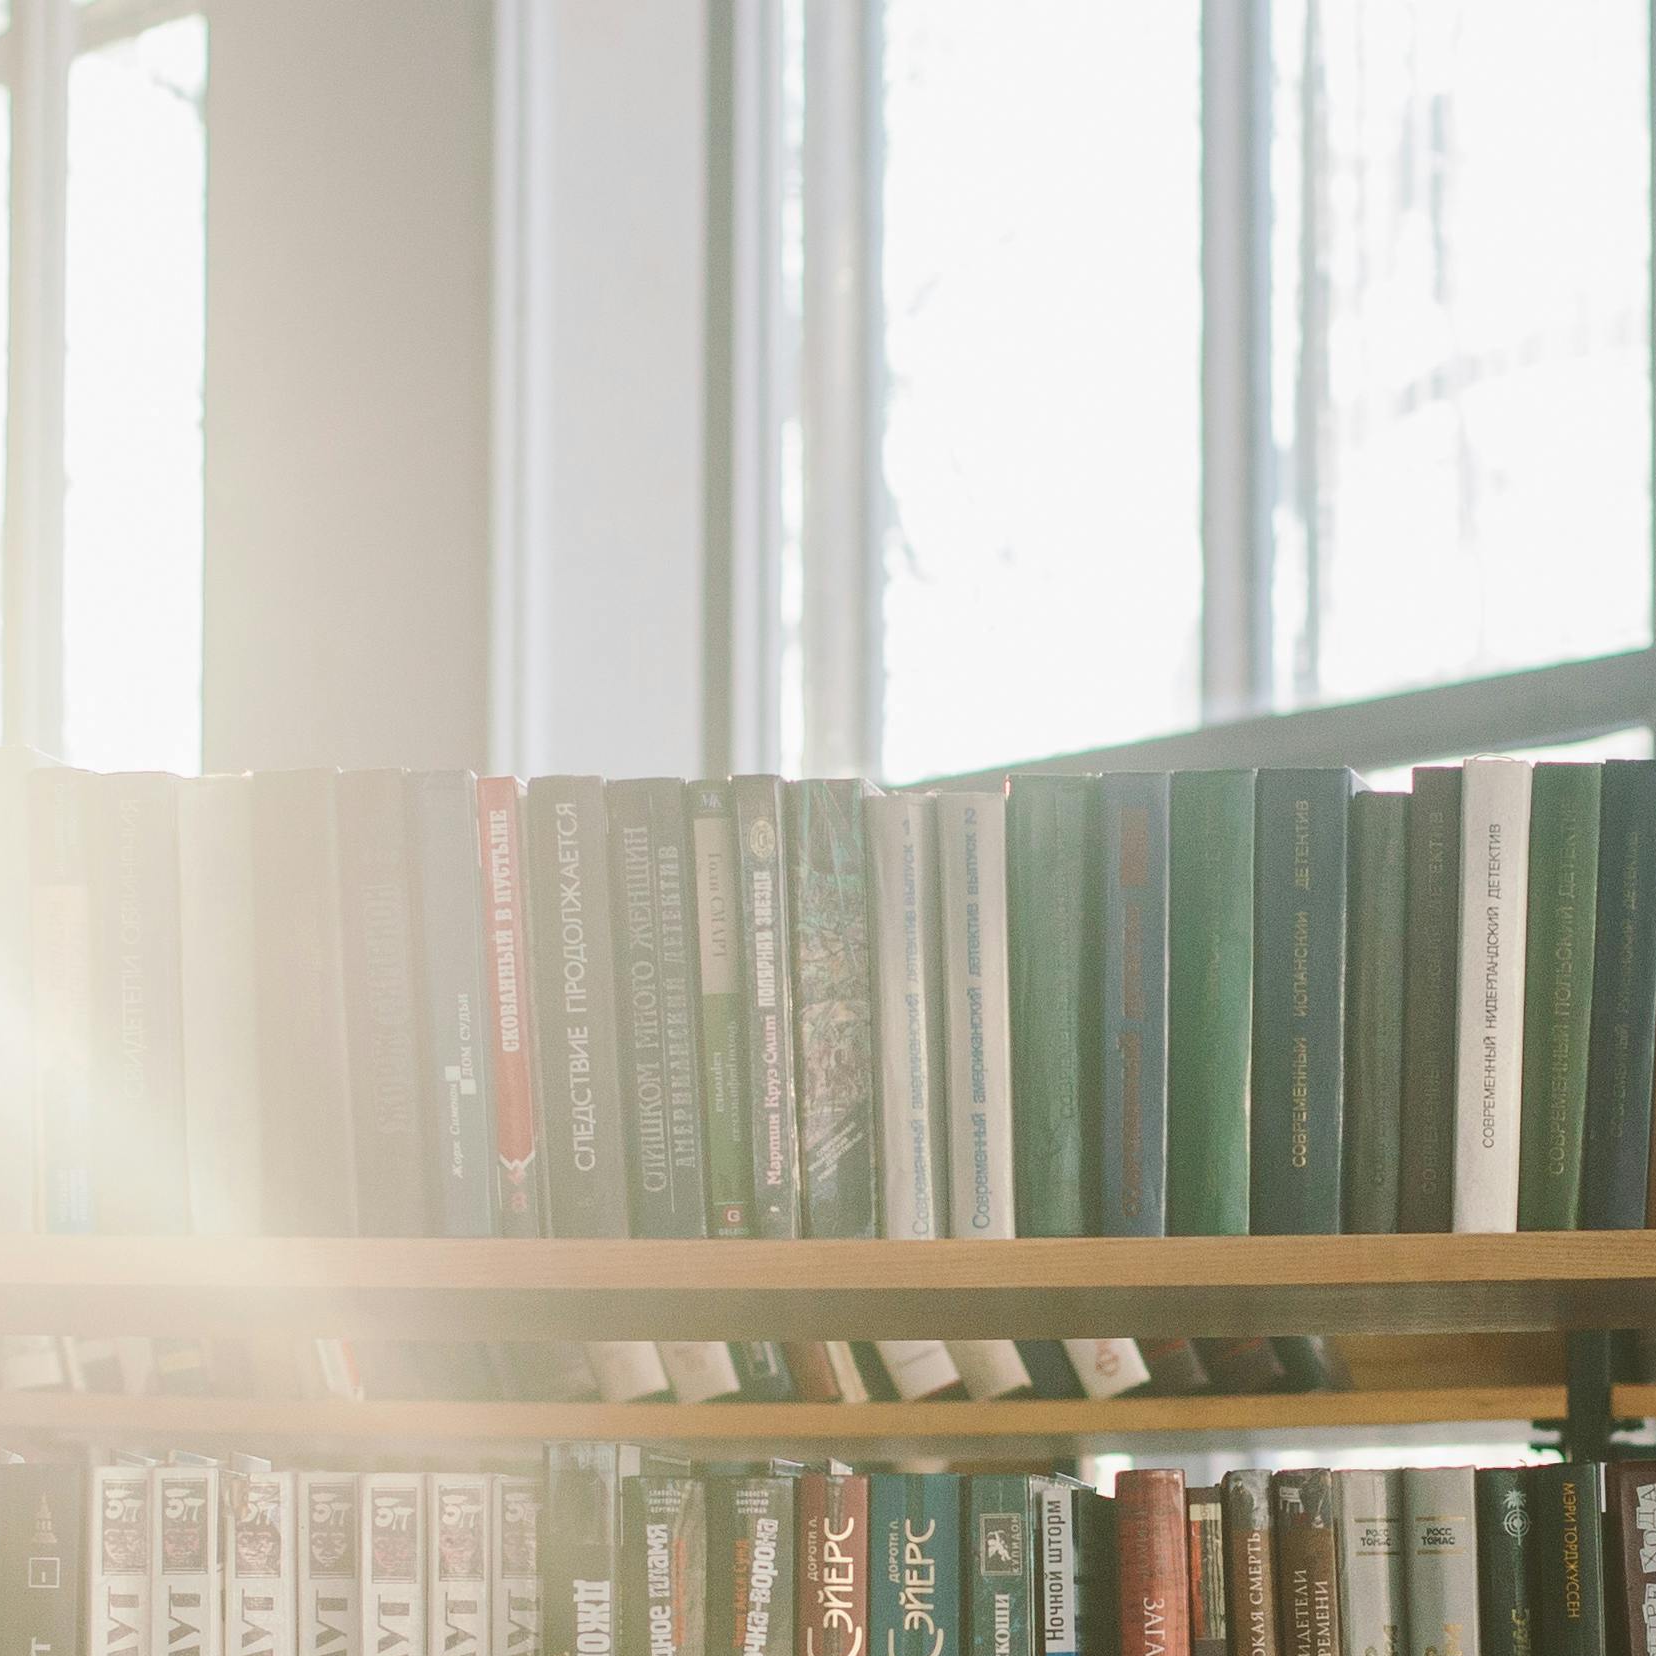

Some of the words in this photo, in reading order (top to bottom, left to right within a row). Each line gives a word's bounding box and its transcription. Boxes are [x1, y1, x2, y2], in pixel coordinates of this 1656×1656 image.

[557, 803, 588, 1013] ПРОДОЛЖАЕТСЯ
[623, 826, 651, 950] ЖЕНЩИН
[1488, 824, 1501, 899] ДЕТЕКТИВ
[632, 961, 657, 1049] МНОГО
[1484, 906, 1500, 1028] НИДЕРЛАНДСКИЙ
[763, 1015, 778, 1064] Смит
[764, 1066, 783, 1107] Круз
[568, 1027, 597, 1171] СЛЕДСТВИЕ
[637, 1063, 667, 1191] СЛИШКОМ
[1482, 1036, 1498, 1148] СОВРЕМЕННЫЙ
[766, 1114, 783, 1184] Мартин
[647, 1524, 668, 1597] пламя
